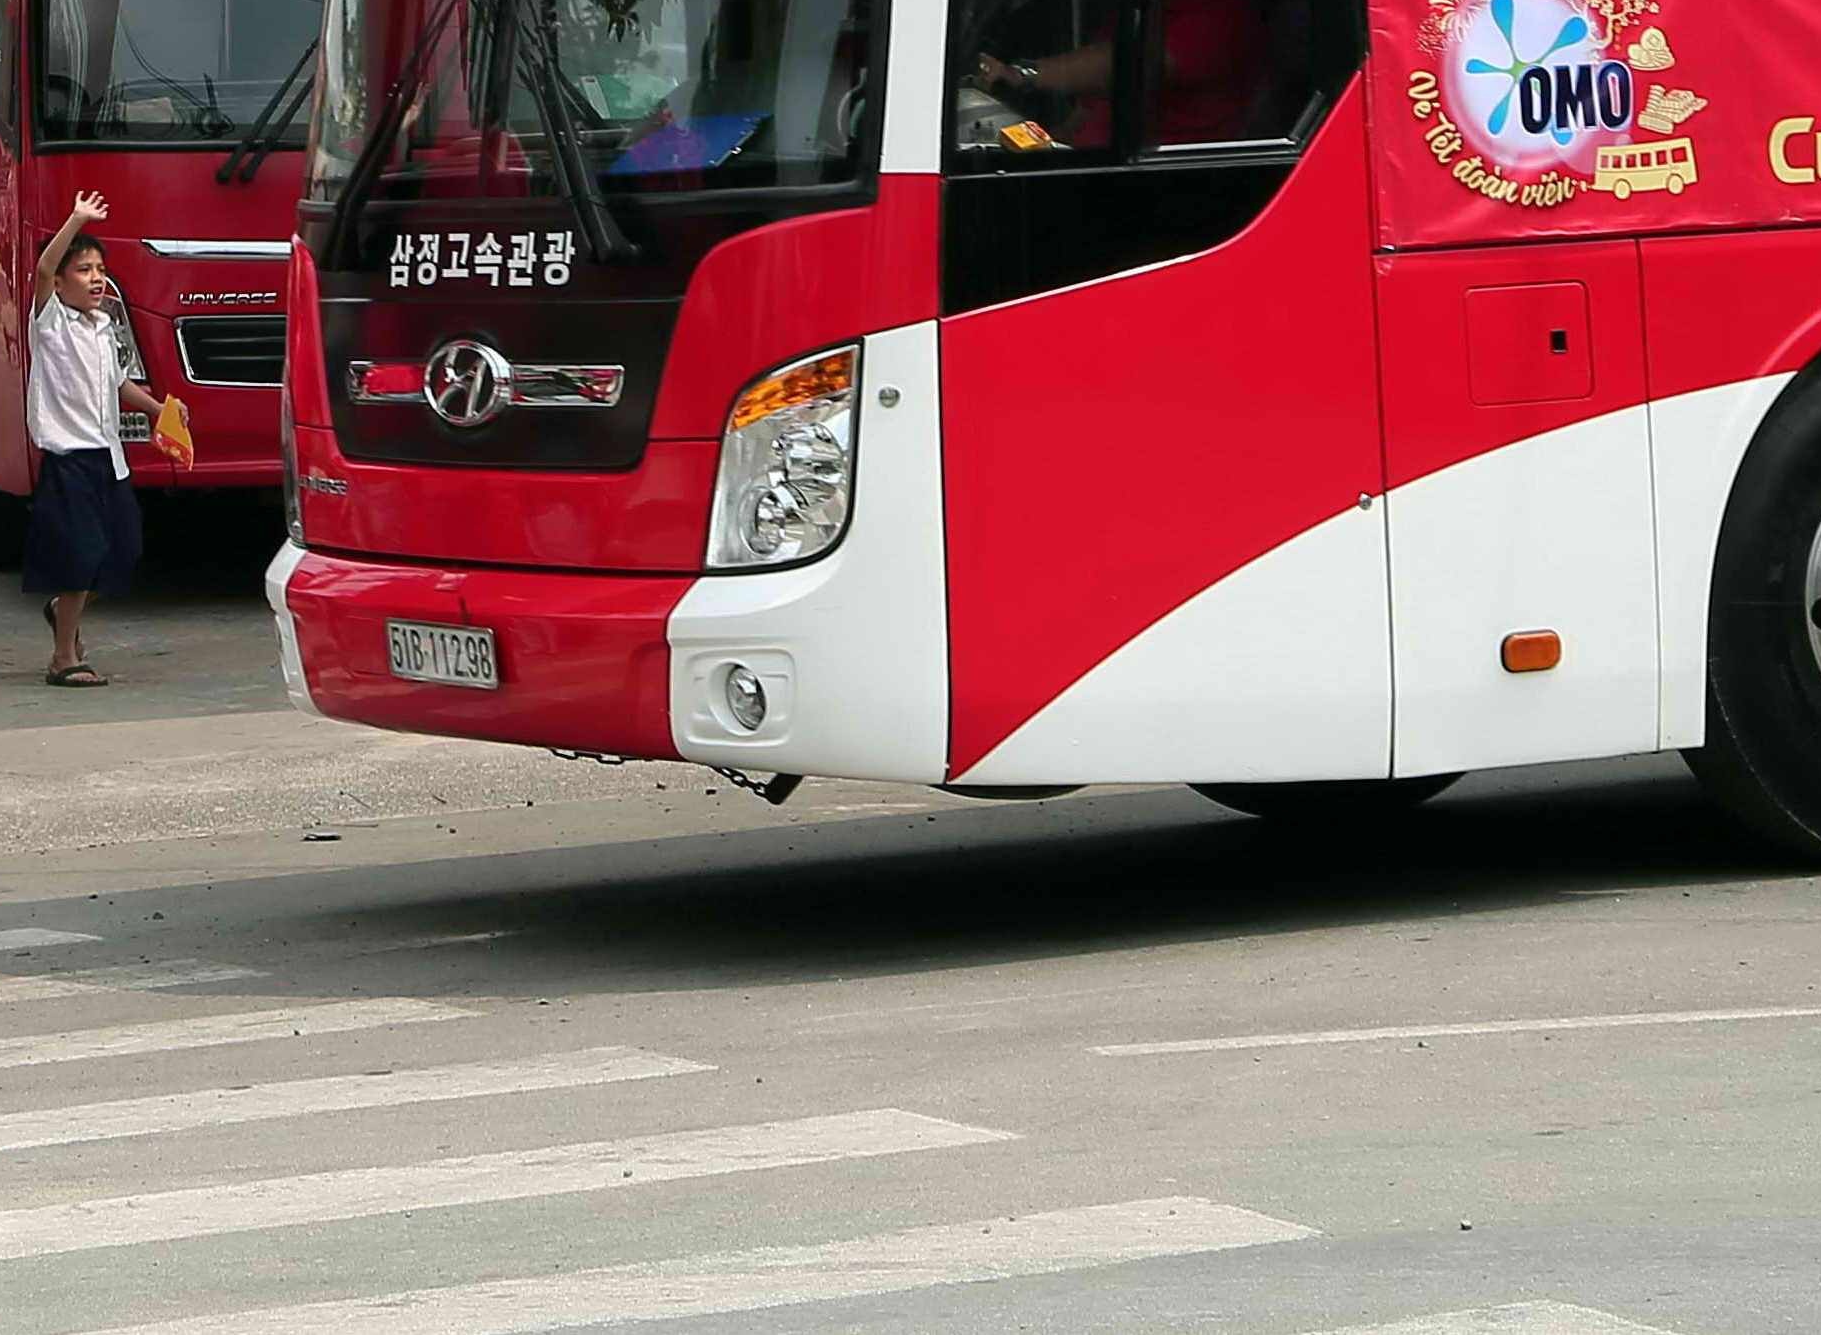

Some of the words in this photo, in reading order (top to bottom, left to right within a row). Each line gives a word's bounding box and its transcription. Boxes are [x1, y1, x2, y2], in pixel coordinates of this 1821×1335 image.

[1519, 61, 1633, 135] OMO
[1407, 70, 1441, 119] Vé
[1425, 111, 1463, 164] Tết
[1452, 155, 1520, 204] đoàn
[1520, 170, 1576, 208] viên
[389, 230, 576, 288] 삼정고속관광
